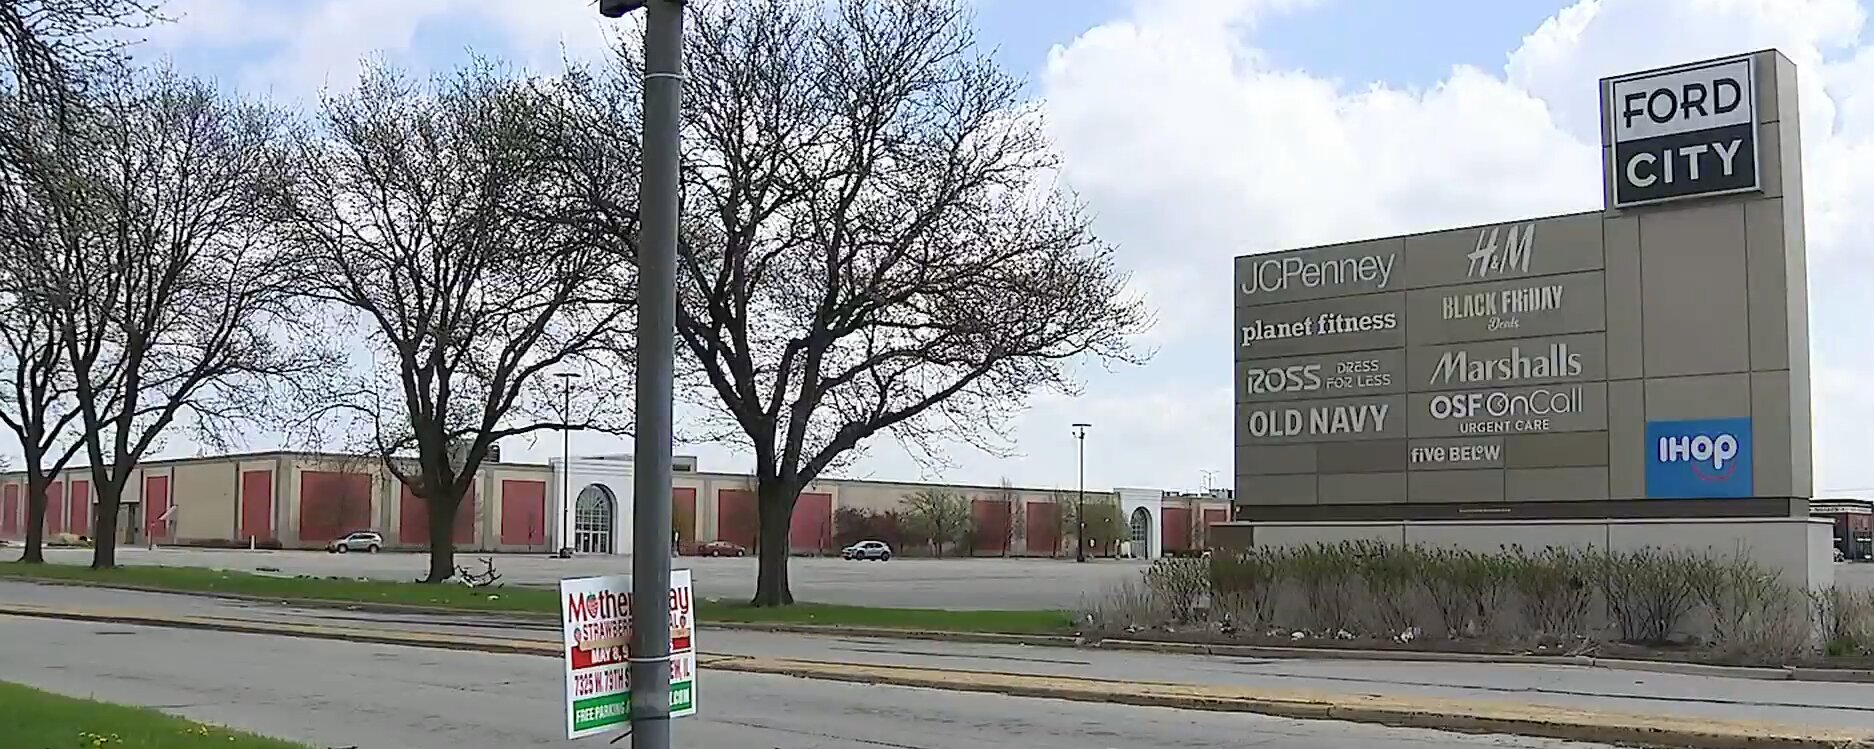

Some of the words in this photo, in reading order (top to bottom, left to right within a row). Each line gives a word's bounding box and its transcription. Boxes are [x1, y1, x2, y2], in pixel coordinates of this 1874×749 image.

[1624, 78, 1741, 128] FORD
[1627, 139, 1743, 187] CITY
[1467, 223, 1536, 278] H&M
[1242, 253, 1395, 295] JCPenney
[1443, 291, 1497, 319] BLACK
[1241, 316, 1313, 346] planet
[1317, 312, 1397, 335] fitness
[1487, 316, 1521, 331] Deals
[1336, 359, 1380, 374] DRESS
[1430, 343, 1583, 385] Marshalls
[1247, 364, 1321, 394] ROSS
[1326, 376, 1353, 390] FOR
[1357, 373, 1392, 388] LESS
[1430, 393, 1483, 420] OSF
[1486, 386, 1584, 418] OnCall
[1250, 409, 1303, 437] OLD
[1309, 404, 1389, 435] NAVY
[1460, 420, 1511, 434] URGENT
[1515, 419, 1549, 431] CARE
[668, 586, 688, 615] ay
[592, 648, 611, 664] MAY
[624, 667, 632, 689] S
[575, 707, 596, 723] FREE
[595, 701, 626, 720] PARKING
